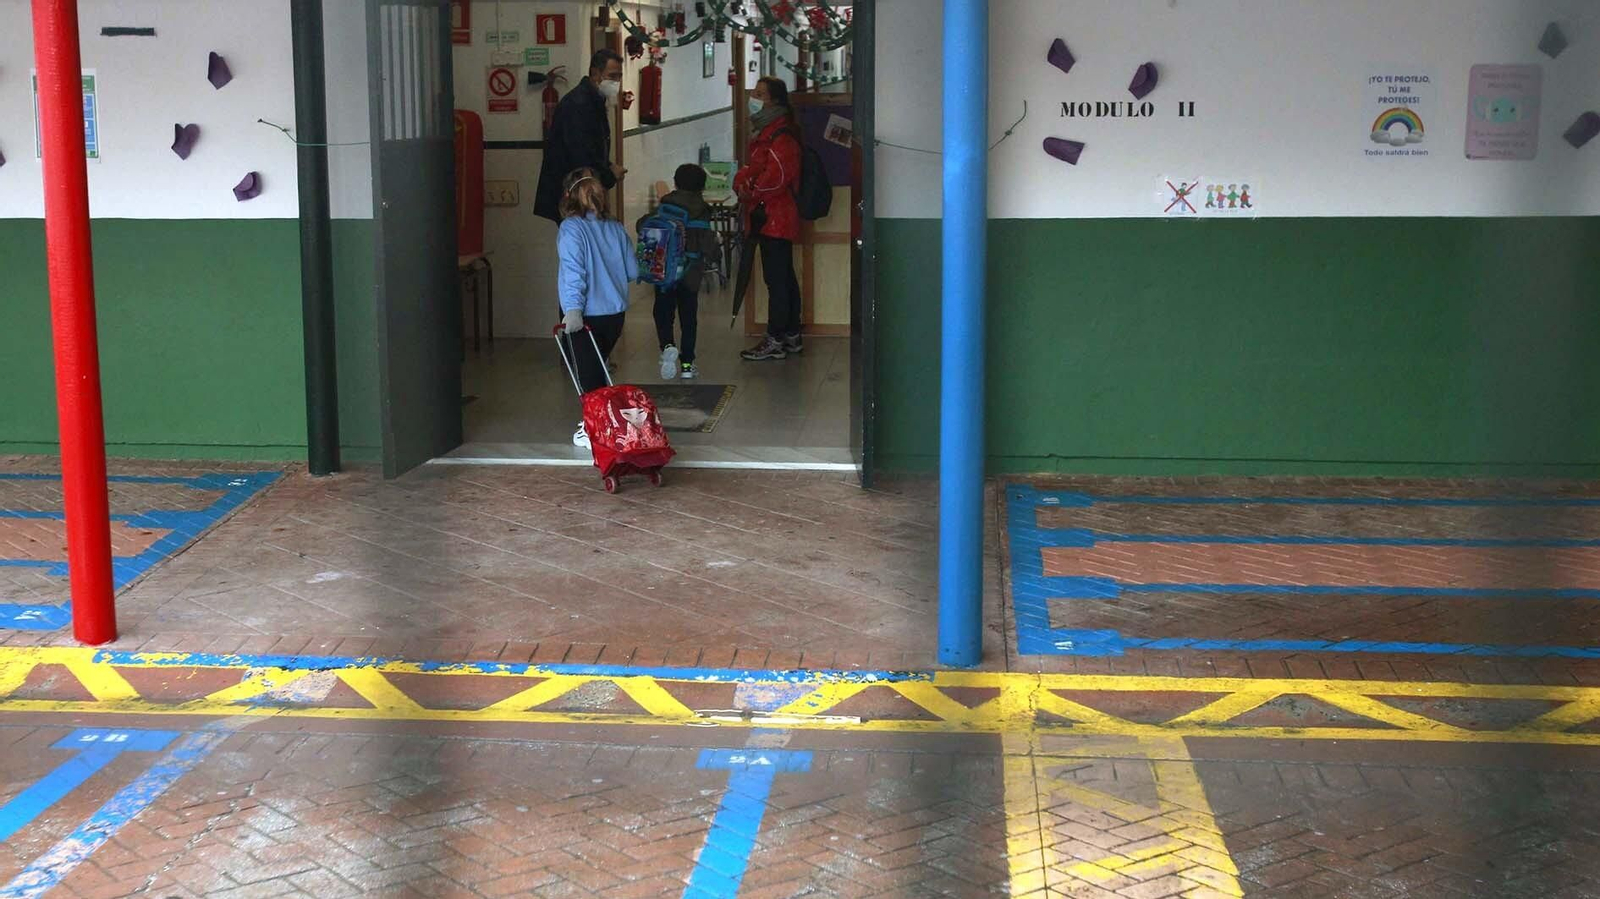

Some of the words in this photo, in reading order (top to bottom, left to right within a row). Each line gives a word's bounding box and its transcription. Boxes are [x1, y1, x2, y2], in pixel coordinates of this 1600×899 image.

[1369, 75, 1383, 84] ¡YO
[1385, 75, 1393, 83] TE
[1394, 75, 1430, 84] PROTEJO,
[1388, 84, 1398, 93] TÚ
[1378, 96, 1420, 104] PROTEGES!
[1060, 101, 1155, 118] MODULO
[1178, 101, 1195, 117] II
